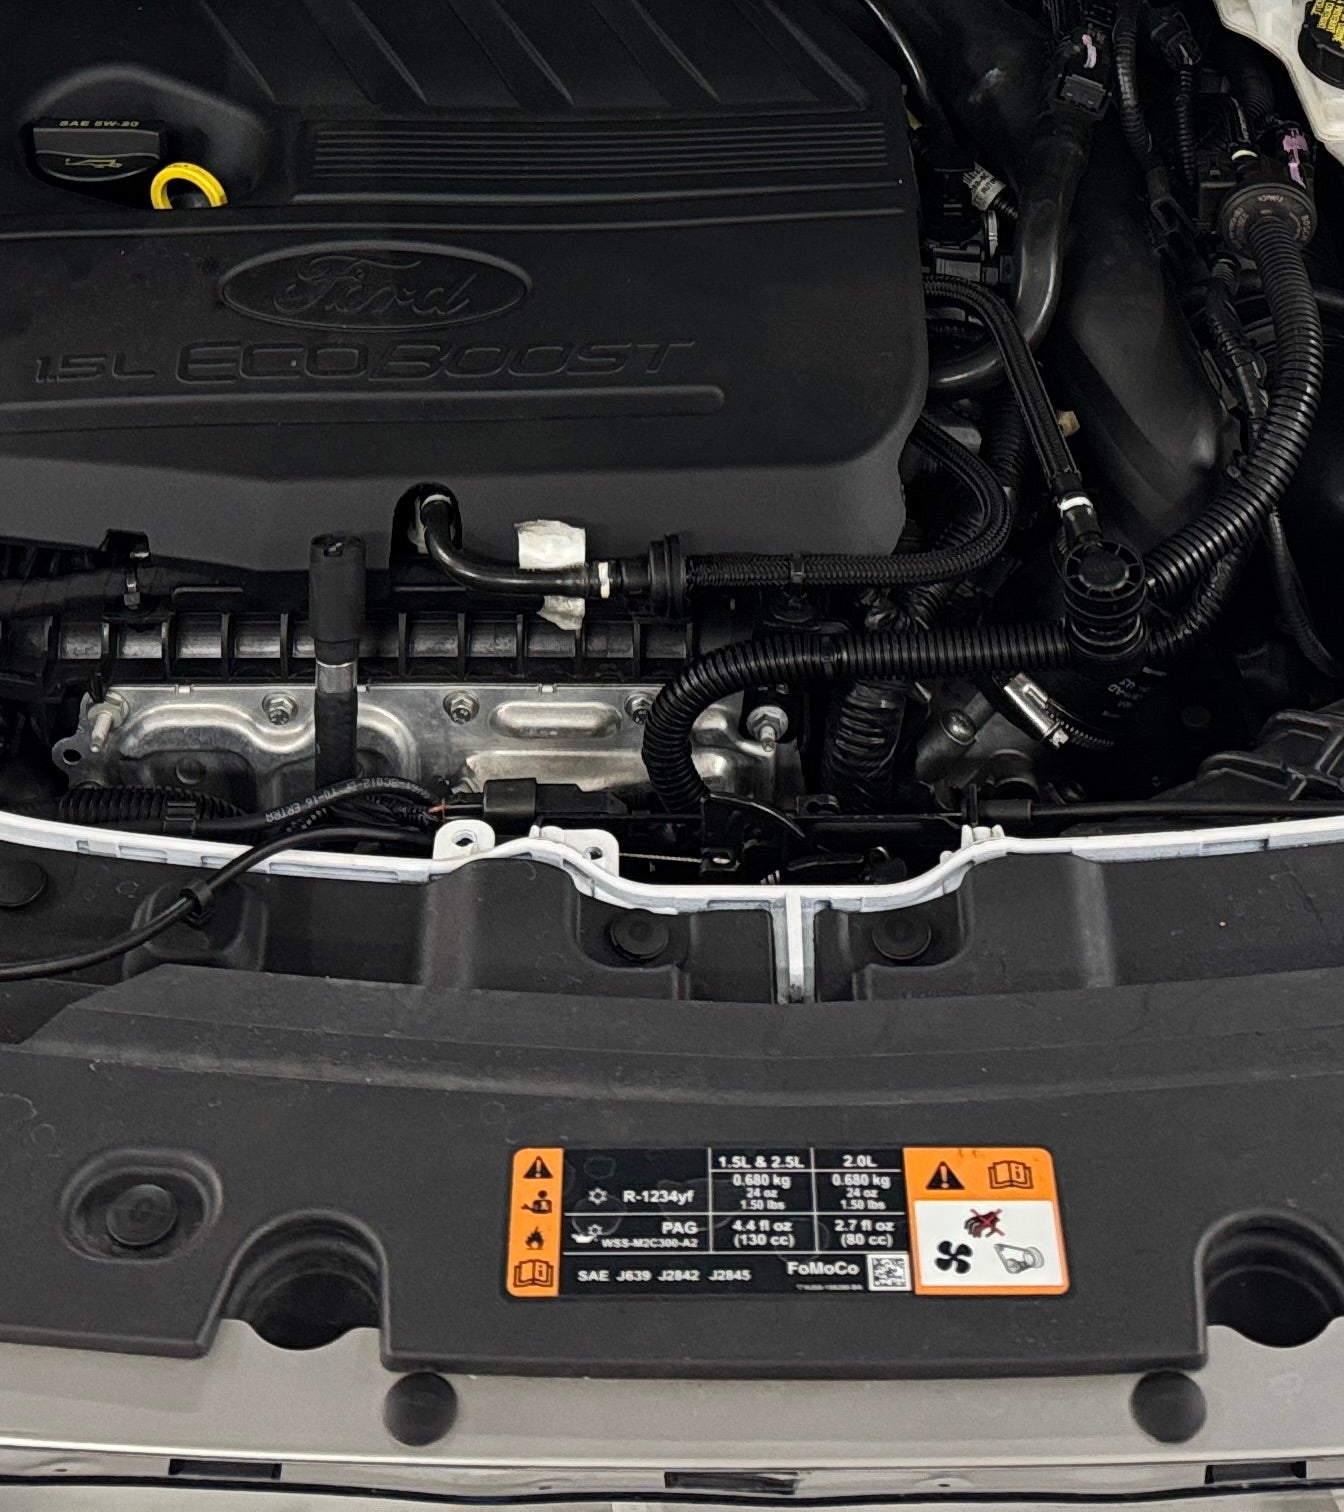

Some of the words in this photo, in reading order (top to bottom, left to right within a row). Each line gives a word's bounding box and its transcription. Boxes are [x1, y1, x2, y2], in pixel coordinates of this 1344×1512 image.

[58, 119, 90, 127] SAE
[94, 119, 140, 128] 5W-20
[272, 254, 479, 317] Ford
[718, 1155, 751, 1169] 1.5L
[754, 1155, 767, 1169] &
[770, 1155, 805, 1169] 2.5L
[842, 1154, 878, 1168] 2.0L
[732, 1173, 769, 1187] 0.680
[772, 1173, 792, 1189] kg
[831, 1173, 869, 1187] 0.680
[872, 1173, 892, 1189] kg
[622, 1189, 695, 1205] R-1234yf
[746, 1188, 761, 1199] 24
[763, 1189, 778, 1199] oz
[845, 1188, 861, 1199] 24
[863, 1189, 879, 1199] oz
[739, 1199, 764, 1211] 1.50
[766, 1199, 786, 1211] lbs
[839, 1199, 865, 1211] 1.50
[867, 1199, 886, 1211] lbs
[661, 1221, 699, 1235] PAG
[731, 1219, 757, 1232] 4.4
[758, 1219, 771, 1232] fl
[772, 1220, 793, 1232] oz
[834, 1219, 859, 1232] 2.7
[860, 1219, 873, 1232] fl
[875, 1220, 896, 1232] oz
[733, 1234, 768, 1248] (130
[770, 1234, 796, 1248] cc)
[840, 1234, 865, 1248] (80
[868, 1234, 894, 1248] cc)
[577, 1269, 611, 1282] SAE
[615, 1269, 653, 1282] J639
[657, 1269, 701, 1282] J2842
[708, 1268, 752, 1282] J2845
[786, 1261, 860, 1276] FoMoCo
